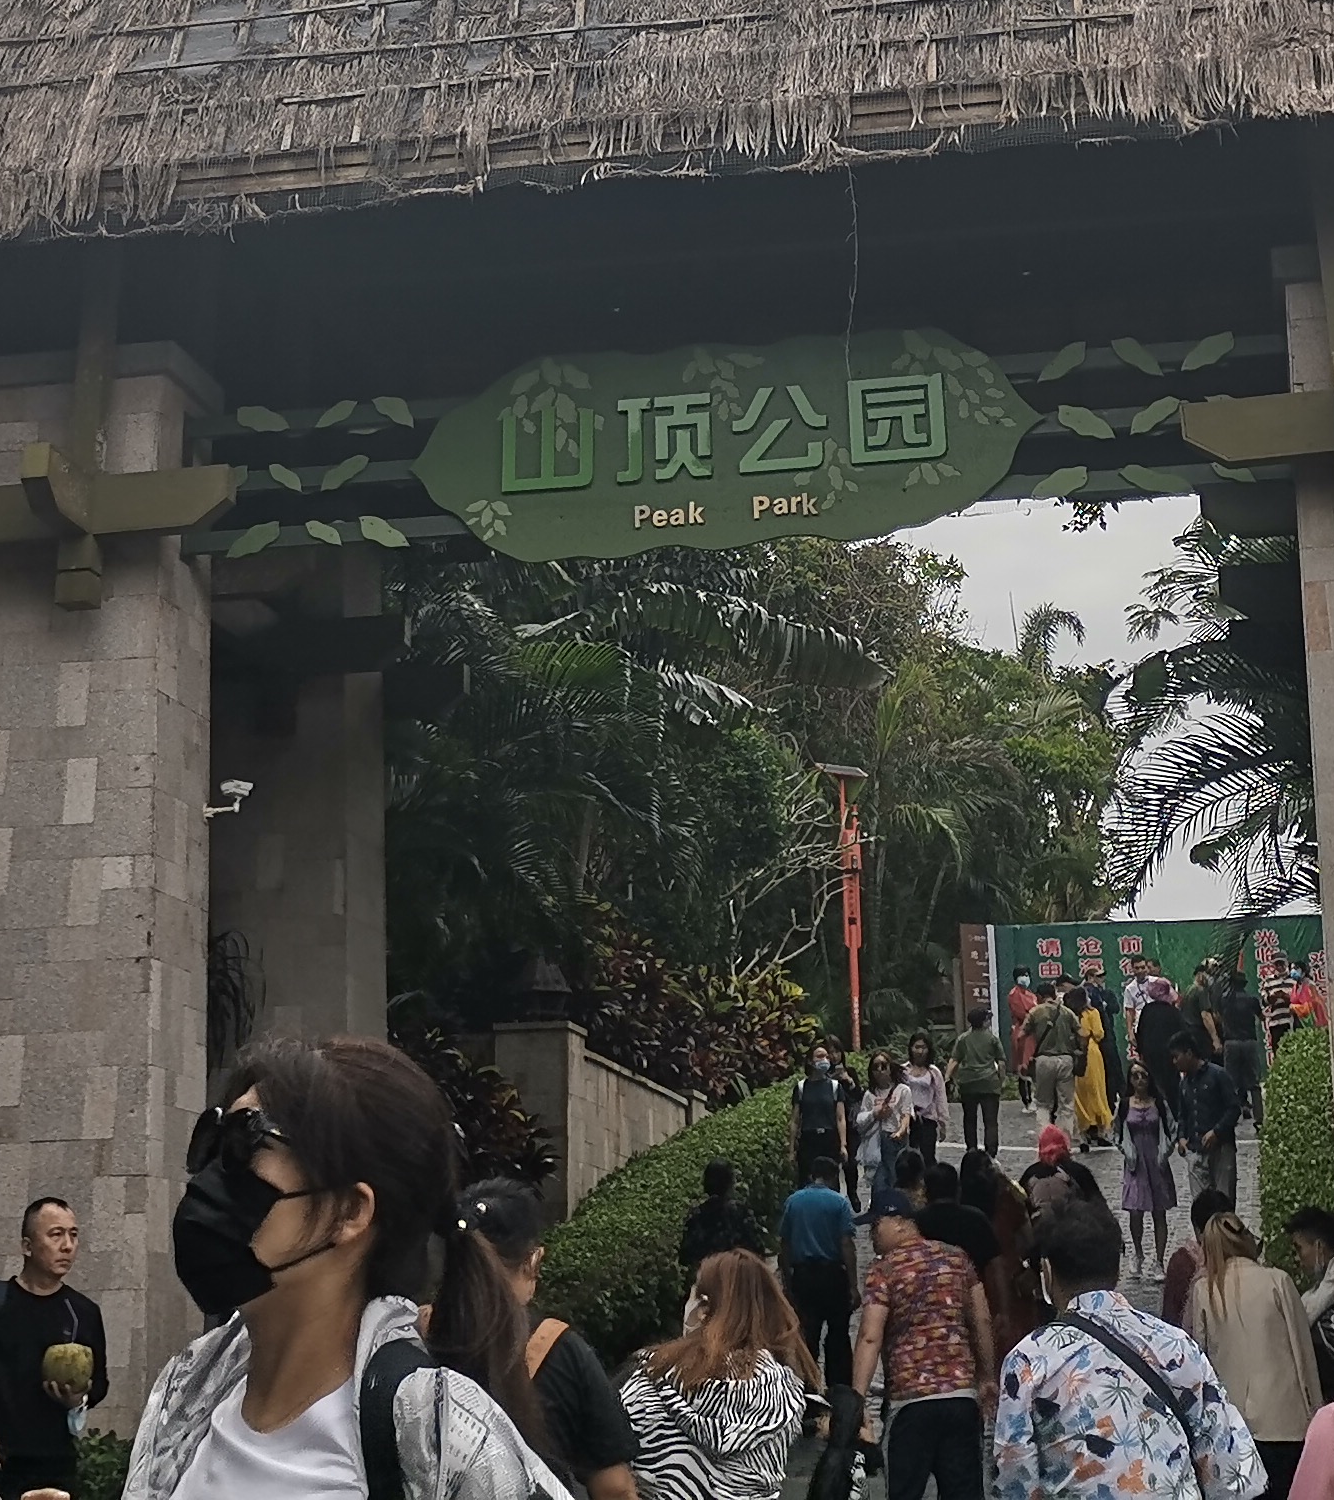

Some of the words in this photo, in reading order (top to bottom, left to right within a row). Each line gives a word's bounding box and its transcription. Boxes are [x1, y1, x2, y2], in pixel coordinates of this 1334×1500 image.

[500, 373, 948, 493] 山顶公园
[634, 501, 705, 529] Peak
[753, 492, 819, 520] Park
